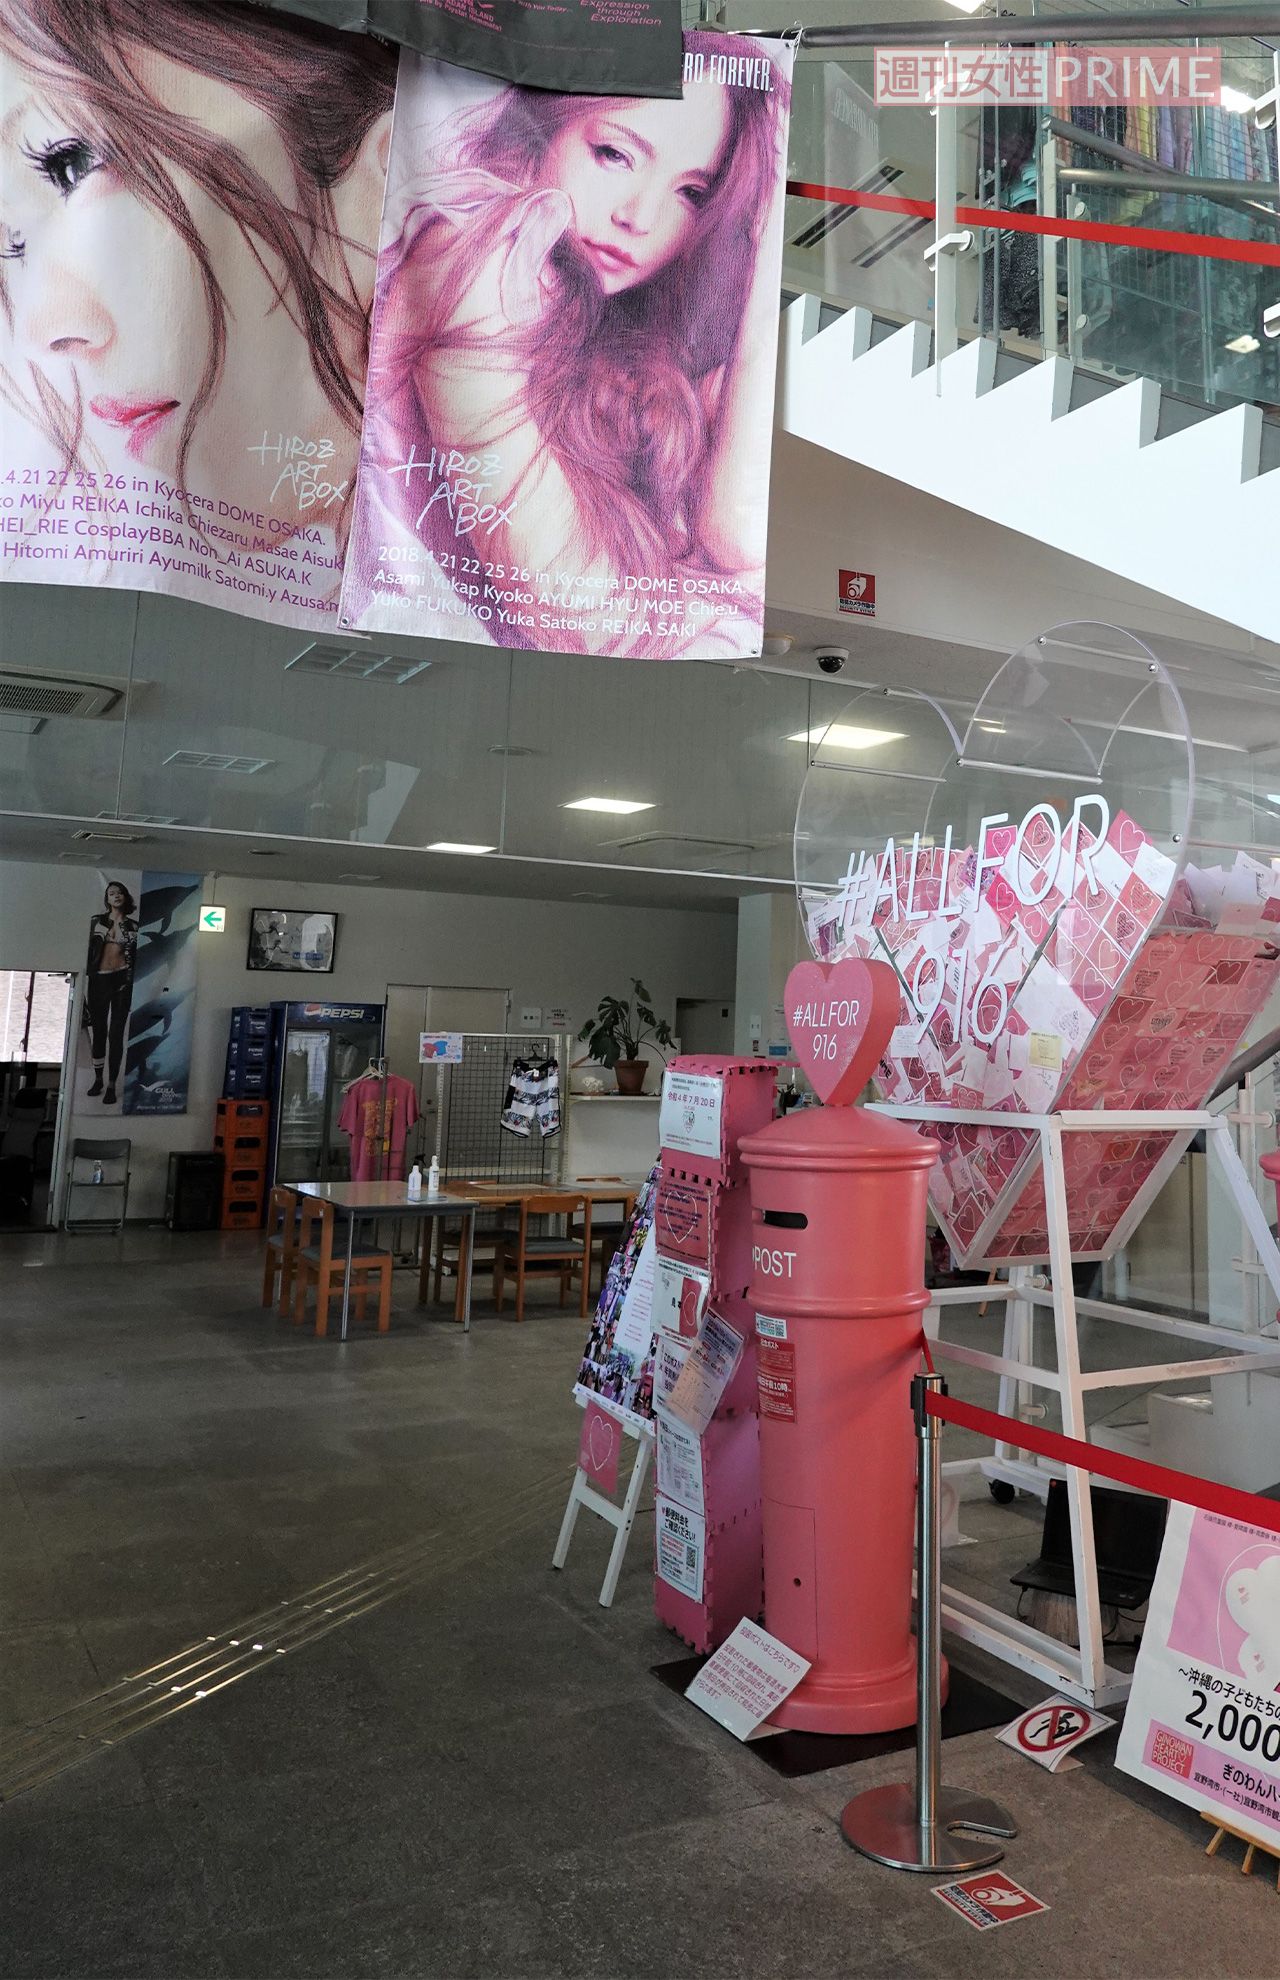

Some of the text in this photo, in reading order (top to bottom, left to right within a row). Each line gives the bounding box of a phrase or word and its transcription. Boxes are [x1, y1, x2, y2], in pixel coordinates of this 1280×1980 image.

[591, 13, 662, 28] Exploration
[682, 52, 774, 92] RO FOREVER.
[270, 461, 327, 502] ART
[298, 481, 348, 510] BOX
[47, 470, 68, 486] 22
[75, 472, 97, 488] 25
[104, 473, 126, 489] 26
[133, 476, 149, 492] in
[155, 479, 214, 513] Kyocera
[219, 500, 264, 529] DOME
[268, 518, 326, 546] OSAKA.
[417, 479, 491, 530] ART
[455, 501, 518, 538] BOX
[20, 493, 65, 515] Miyu
[73, 495, 129, 514] REIKA
[136, 500, 183, 525] Ichika
[188, 514, 248, 546] Chiezaru
[252, 536, 298, 561] Masae
[74, 520, 184, 549] CosplayBBA
[4, 542, 68, 559] Hitomi
[73, 544, 144, 564] Amuriri
[149, 551, 211, 580] Ayumilk
[461, 557, 480, 575] 22
[484, 562, 505, 579] 25
[510, 566, 530, 582] 26
[535, 569, 549, 584] in
[555, 572, 620, 590] Kyocera
[625, 576, 679, 593] DOME
[683, 579, 746, 595] OSAKA.
[374, 569, 425, 587] Asami
[484, 584, 534, 605] Kyoko
[538, 591, 596, 610] AYUMI
[600, 597, 639, 614] HYU
[644, 600, 685, 616] MOE
[371, 589, 696, 637] Yuko FUKUKO Yuka Satoko REIKA SAKI
[837, 794, 1110, 928] #ALLFOR
[913, 934, 1015, 1045] 916
[320, 1008, 364, 1018] PEPSI
[793, 1000, 859, 1029] #ALLFOR
[812, 1033, 838, 1061] 916
[1152, 1752, 1185, 1775] PROJECT
[1154, 1743, 1179, 1759] HEART
[1223, 1763, 1280, 1803] ぎのわんハ
